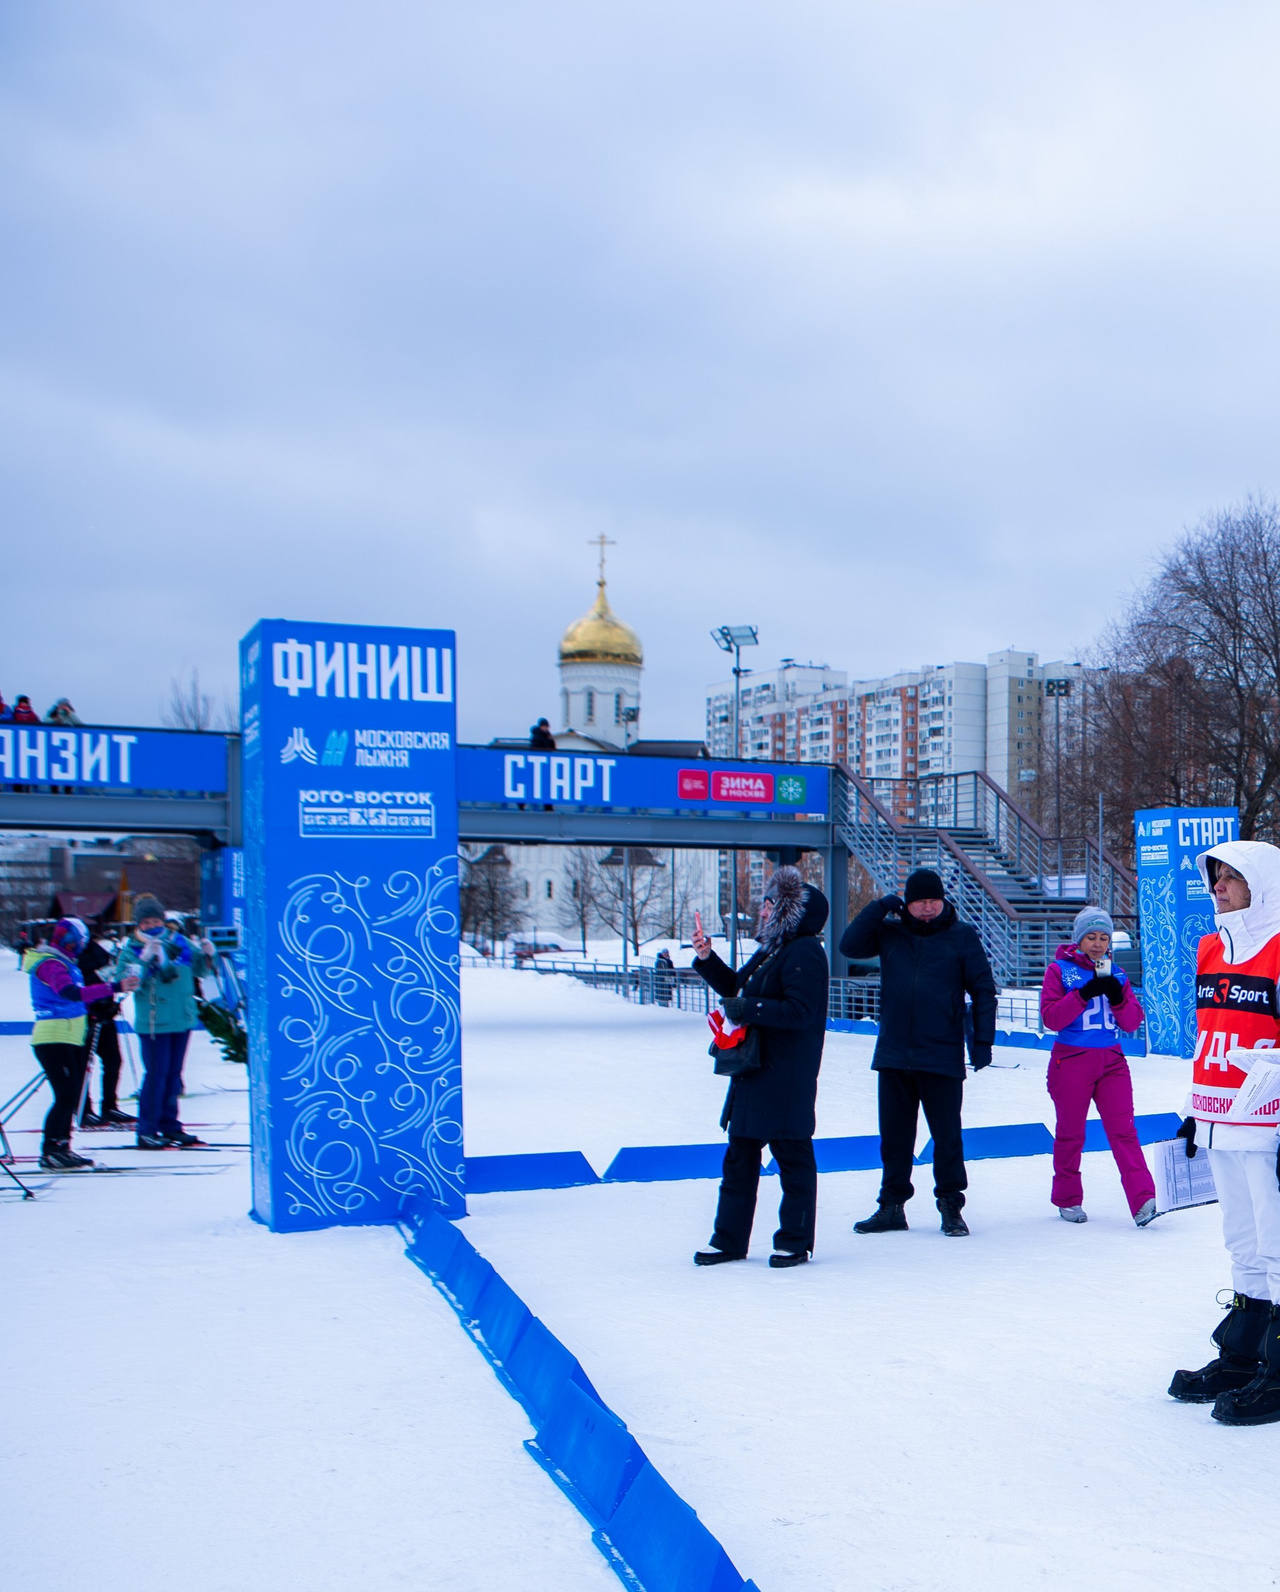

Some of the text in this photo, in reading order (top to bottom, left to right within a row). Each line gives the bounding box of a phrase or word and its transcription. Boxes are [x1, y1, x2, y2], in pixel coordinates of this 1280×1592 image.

[272, 638, 452, 702] ФИНИШ
[355, 729, 450, 750] МОСКОВСКАЯ
[355, 750, 409, 767] ЛЫЖНЯ
[504, 754, 616, 801] СТАРТ
[721, 776, 765, 790] ЗИМА
[299, 790, 434, 805] ЮГО-ВОСТОК
[729, 789, 765, 798] МОСКВЕ
[1178, 817, 1235, 846] СТАРТ
[1229, 985, 1270, 1004] Sport
